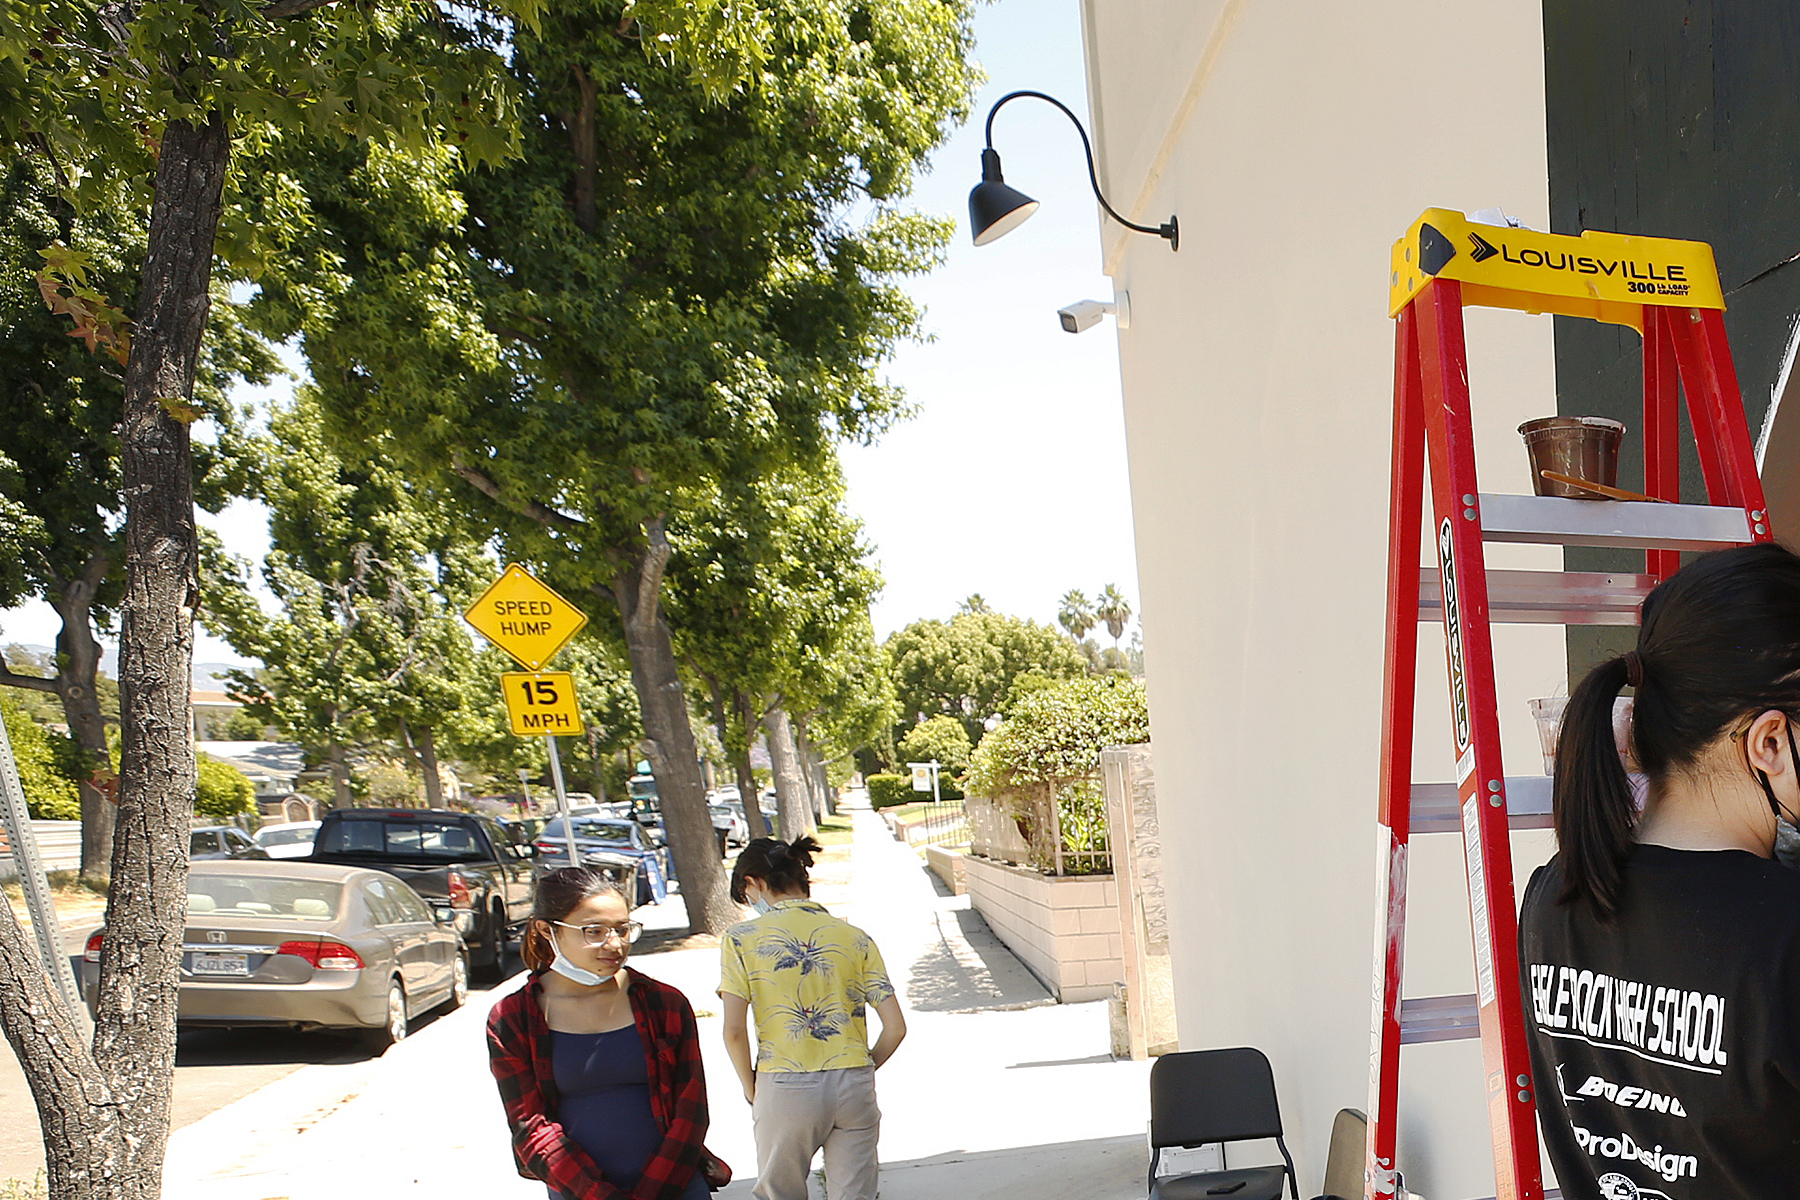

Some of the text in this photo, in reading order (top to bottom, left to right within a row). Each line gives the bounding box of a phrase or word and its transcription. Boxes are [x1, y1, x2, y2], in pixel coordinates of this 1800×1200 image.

[1502, 243, 1688, 282] LOUISVILLE
[1627, 281, 1656, 294] 300
[494, 601, 552, 616] SPEED
[500, 621, 552, 636] HUMP
[1445, 558, 1468, 745] LOUISVILLE
[521, 681, 558, 705] 15
[522, 713, 570, 728] MPH
[1647, 986, 1728, 1066] SCHOOL
